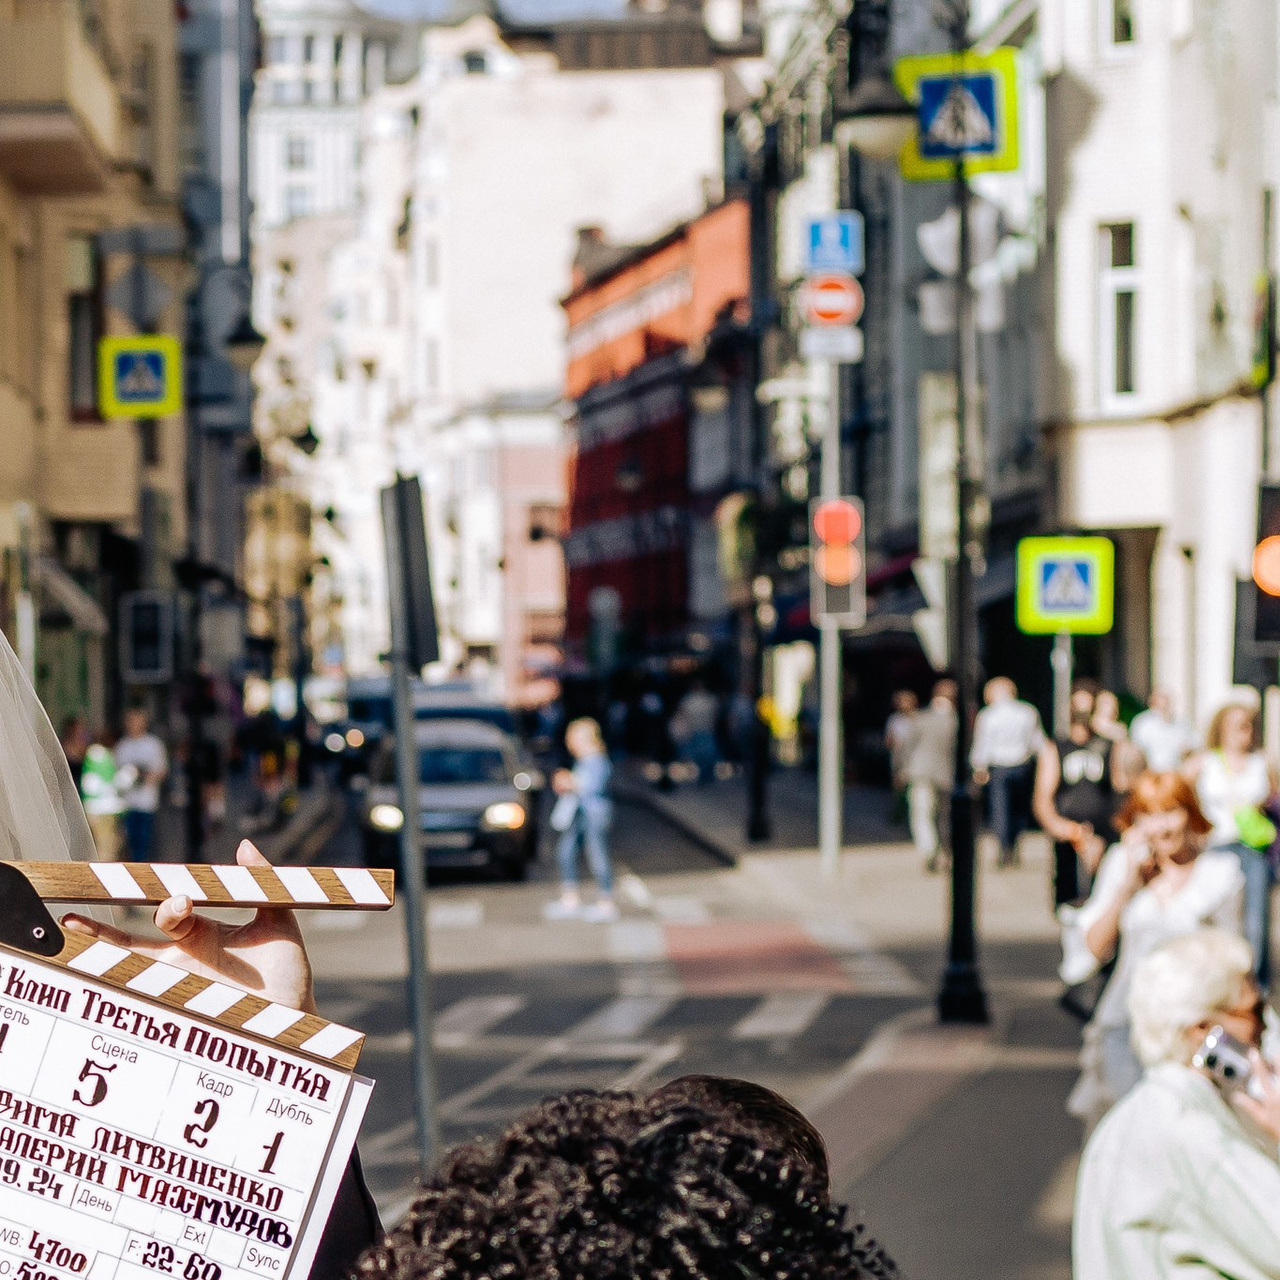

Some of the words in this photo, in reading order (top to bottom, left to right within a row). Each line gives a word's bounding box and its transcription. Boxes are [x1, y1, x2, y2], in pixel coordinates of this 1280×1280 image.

[91, 1035, 138, 1064] Сцена
[72, 1057, 118, 1107] 5
[196, 1070, 234, 1098] Кадр
[183, 1098, 220, 1149] 2
[266, 1097, 314, 1127] Дубль
[258, 1131, 285, 1175] 1
[91, 1126, 284, 1212] ЛИТВИНЕНКО
[77, 1188, 114, 1213] День
[115, 1165, 293, 1249] МАХМУДОВ
[127, 1239, 142, 1257] F:
[183, 1225, 207, 1245] Ext
[28, 1230, 88, 1273] 4700
[246, 1247, 281, 1271] Sync
